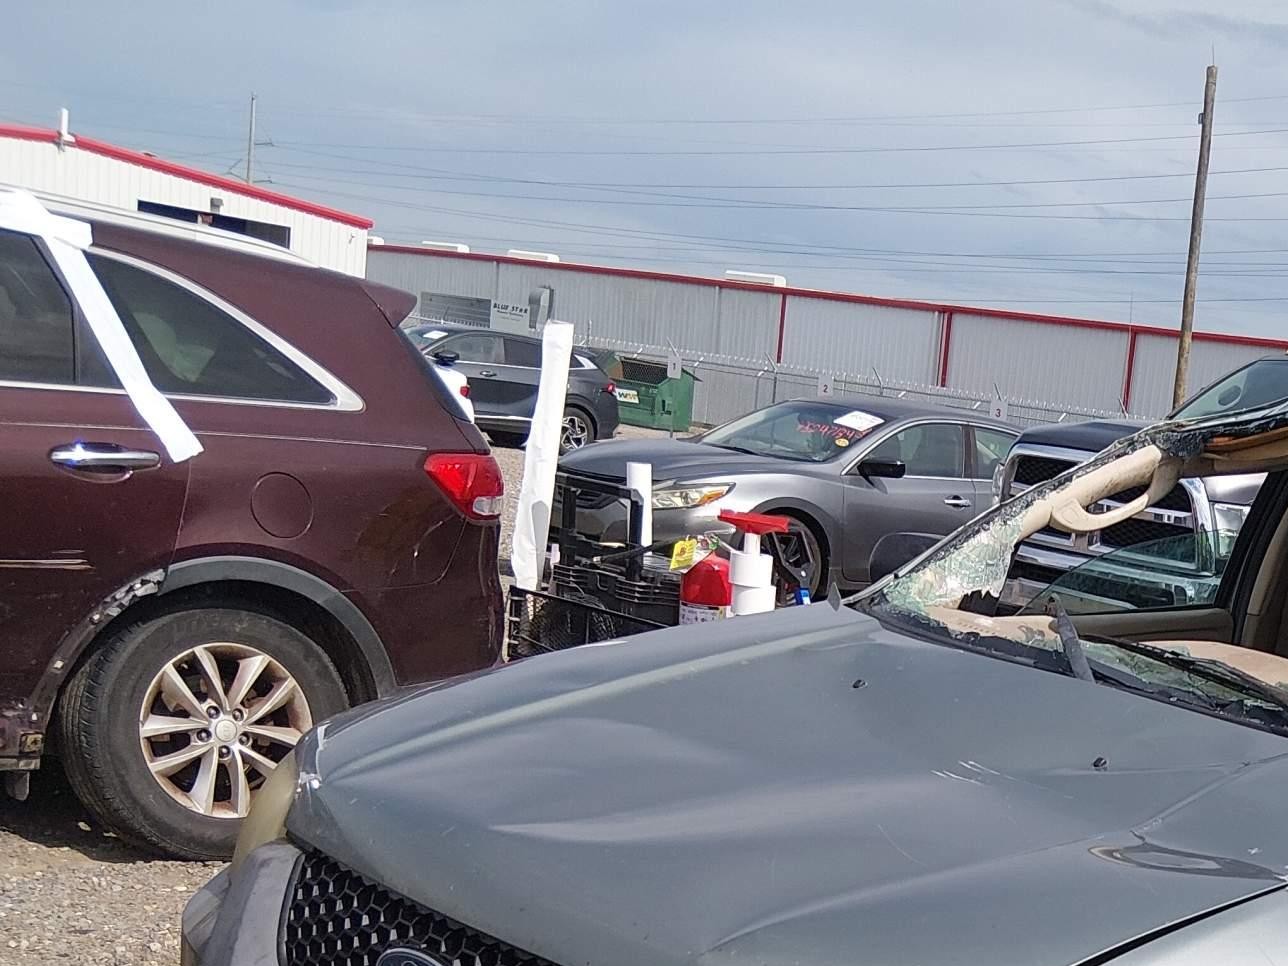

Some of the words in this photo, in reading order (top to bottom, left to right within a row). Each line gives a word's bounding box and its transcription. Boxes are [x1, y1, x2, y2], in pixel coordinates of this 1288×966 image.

[511, 305, 528, 314] STAR
[823, 384, 829, 393] 2
[995, 408, 1002, 417] 3
